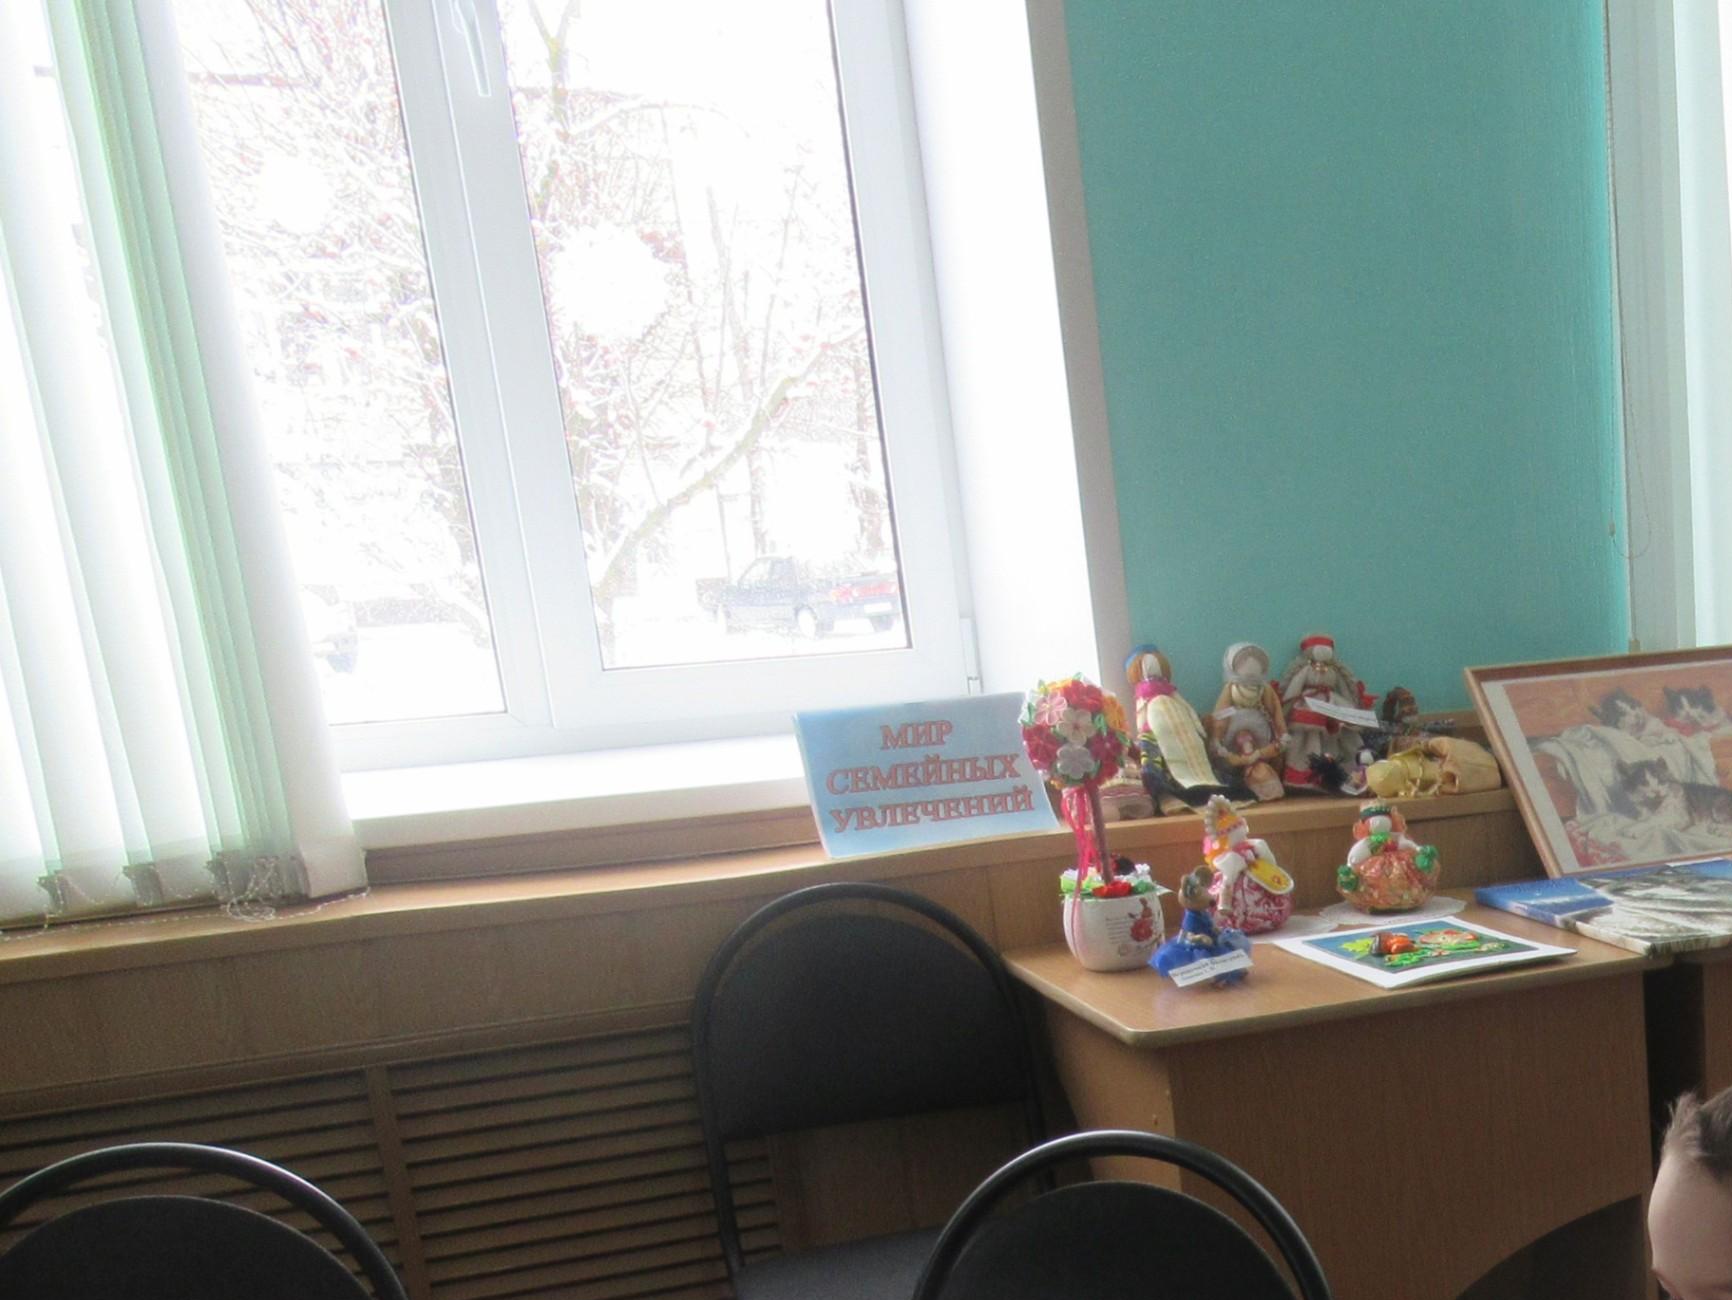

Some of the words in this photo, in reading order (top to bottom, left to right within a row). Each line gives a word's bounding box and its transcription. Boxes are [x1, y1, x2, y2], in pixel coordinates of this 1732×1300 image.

[881, 721, 952, 749] МИР
[827, 754, 1020, 794] СЕМЕЙНЫХ
[830, 786, 1034, 832] УВЛЕЧЕНИЙ
